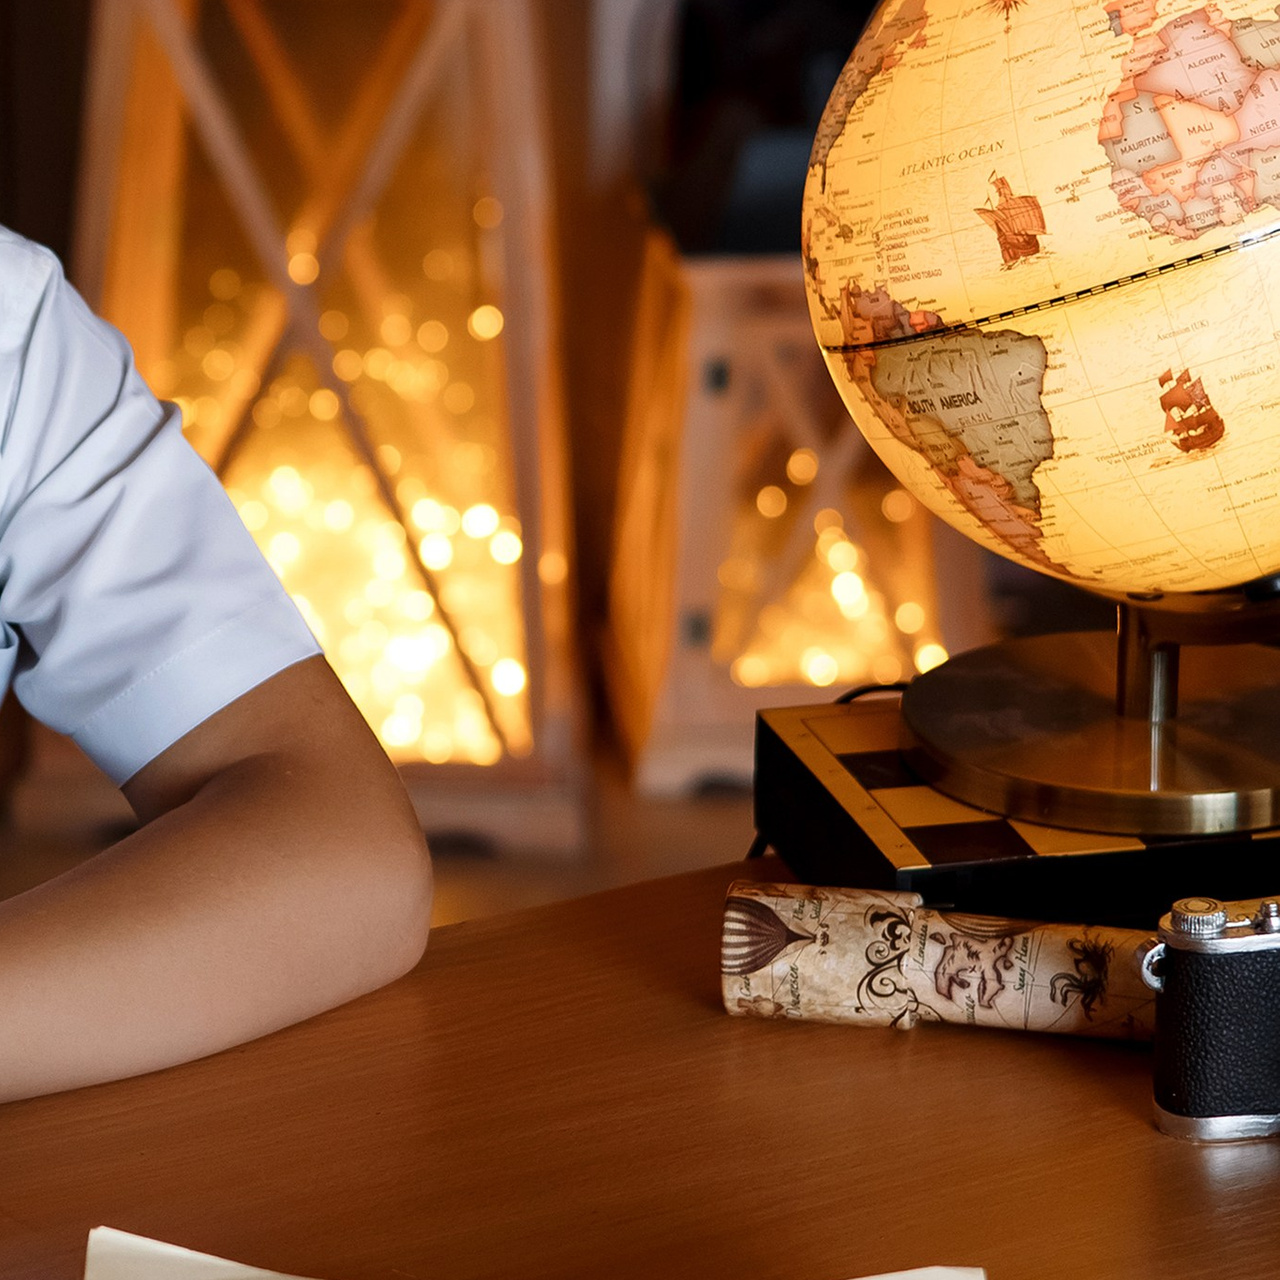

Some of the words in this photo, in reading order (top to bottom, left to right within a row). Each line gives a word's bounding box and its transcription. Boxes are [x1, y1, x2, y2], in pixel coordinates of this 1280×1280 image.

[1188, 53, 1226, 69] ALGERIA
[1187, 122, 1214, 136] MALI
[1249, 119, 1278, 136] NIGER
[1120, 132, 1170, 155] MAURITANIA
[899, 152, 955, 178] ATLANTIC
[958, 140, 1005, 161] OCEAN
[1145, 199, 1172, 213] GUINEA
[907, 398, 937, 414] SOUTH
[939, 391, 983, 410] AMERICA
